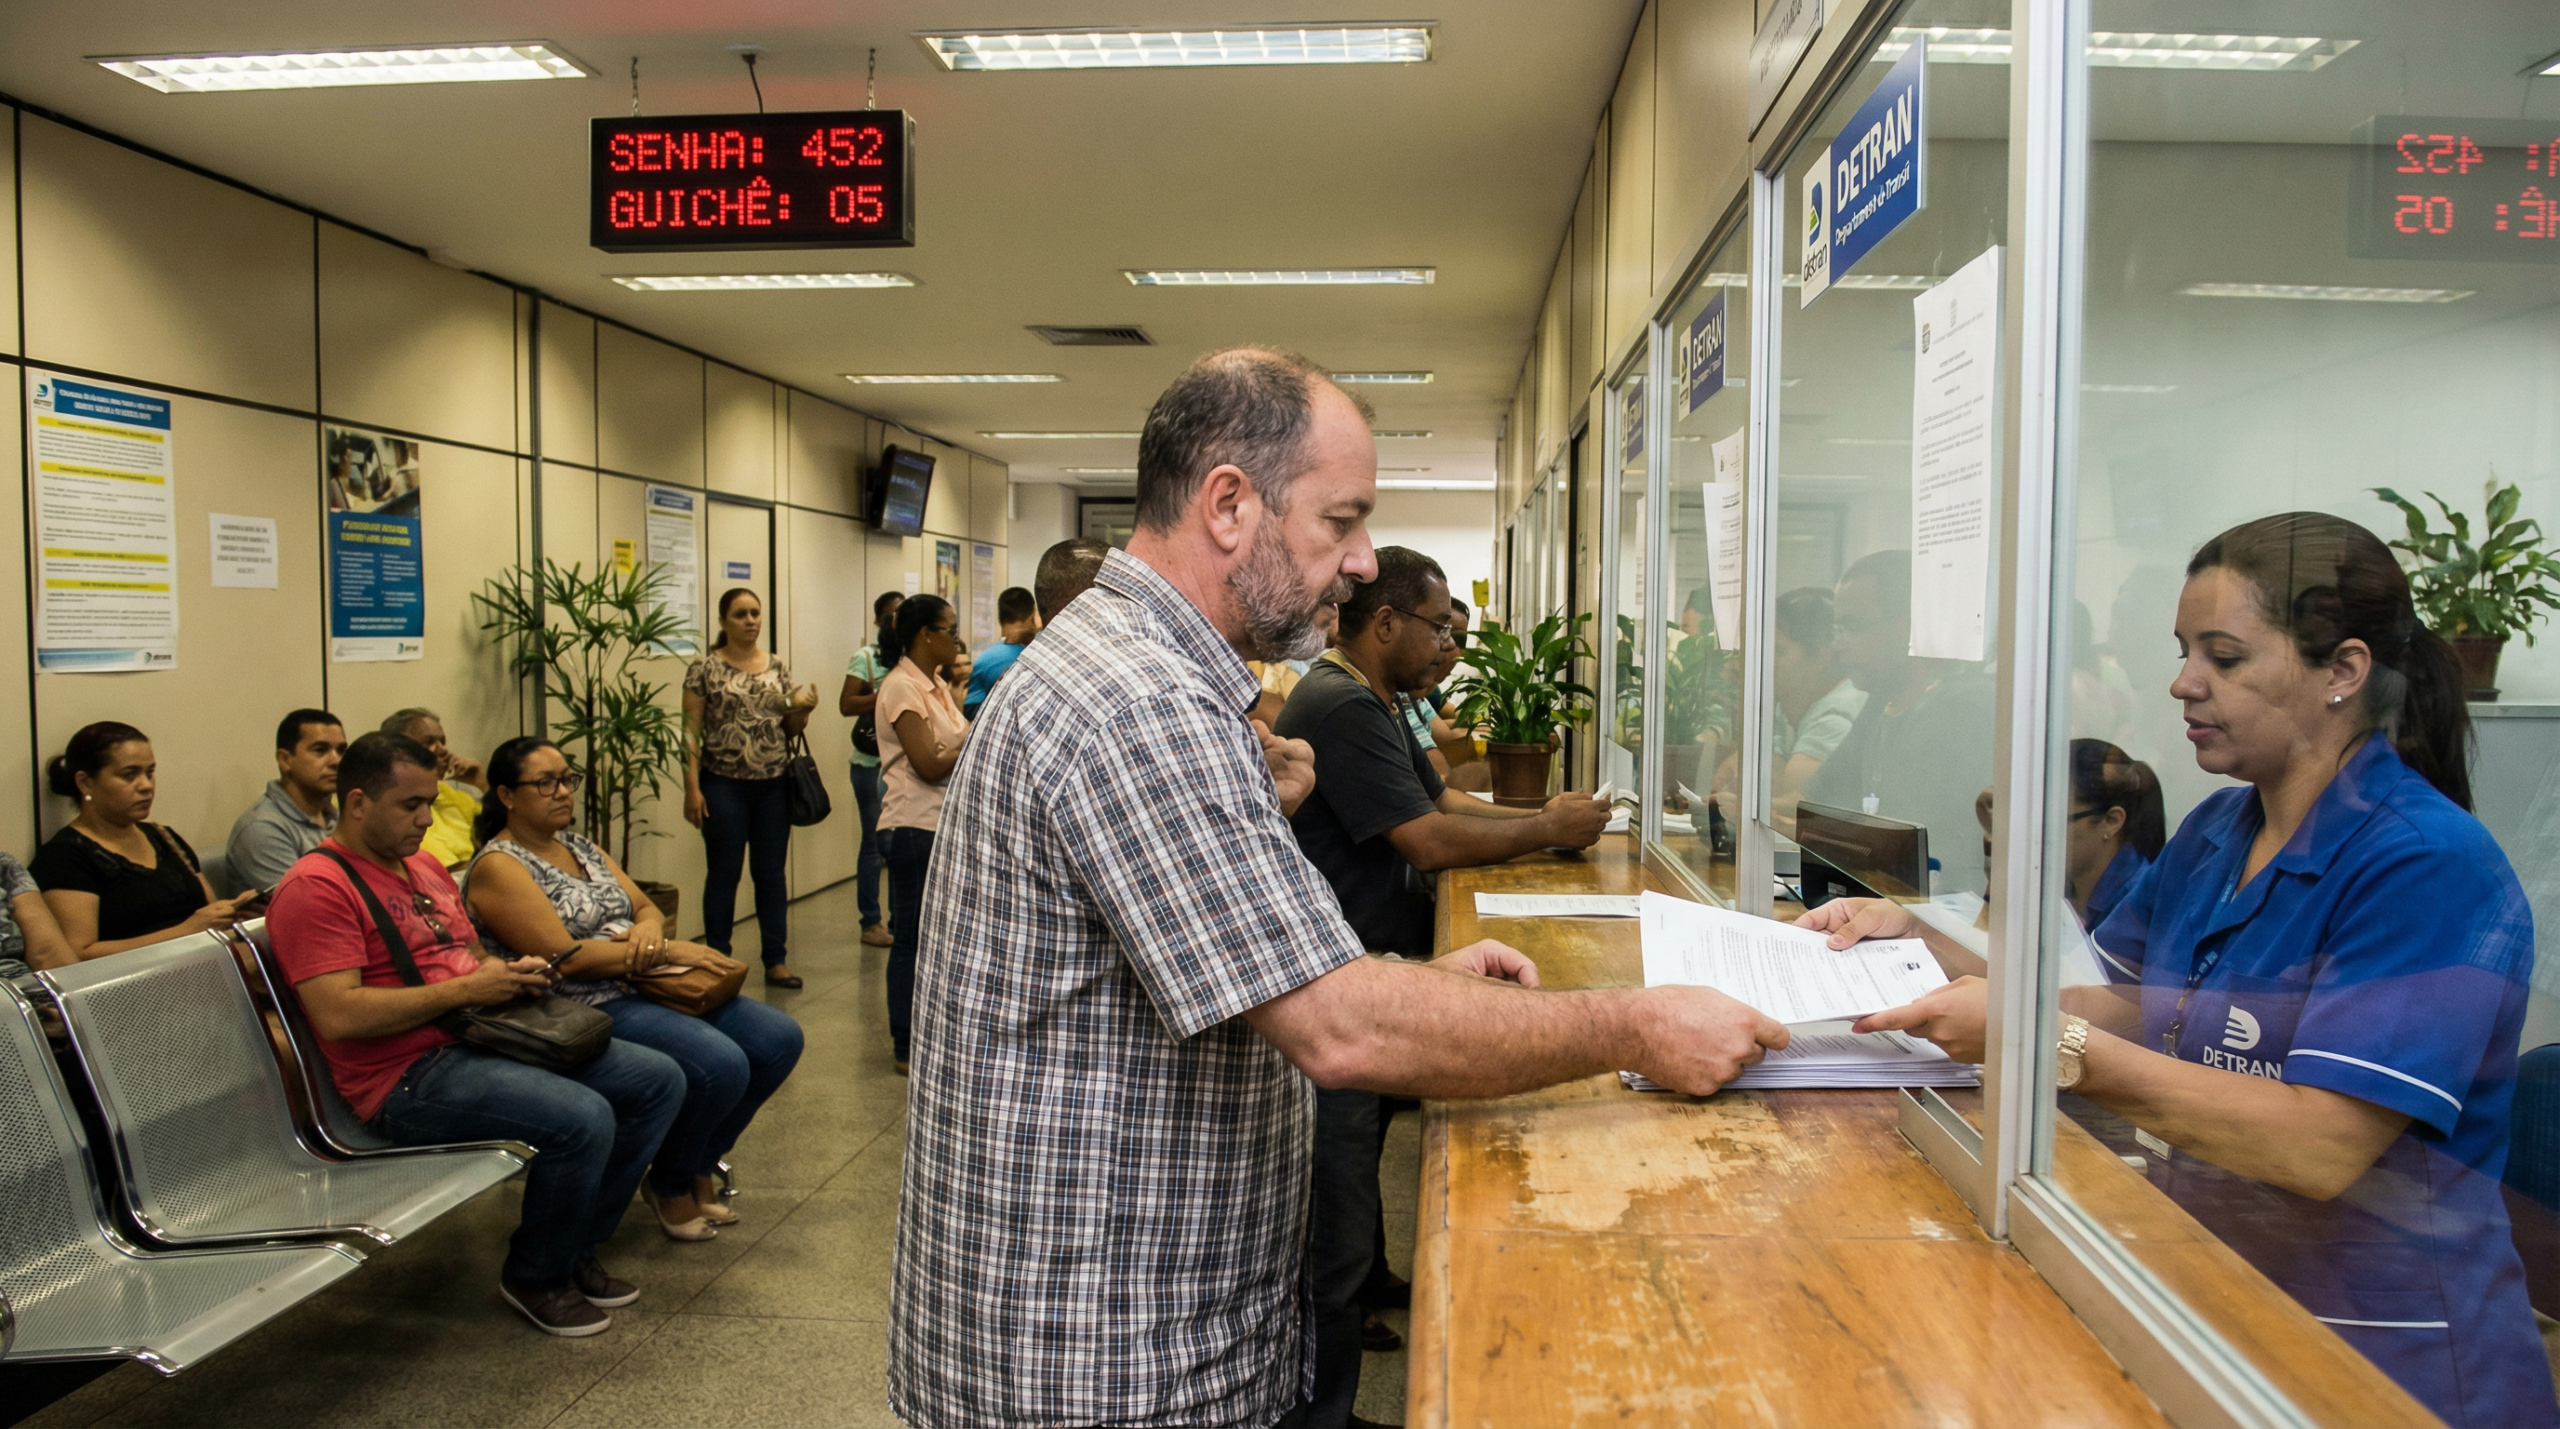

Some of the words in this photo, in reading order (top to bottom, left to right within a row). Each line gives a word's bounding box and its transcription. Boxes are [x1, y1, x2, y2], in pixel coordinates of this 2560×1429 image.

[610, 131, 764, 171] SENHA:
[802, 127, 883, 167] 452
[1837, 83, 1912, 214] DETRAN
[610, 175, 790, 228] GUICHÊ:
[829, 185, 883, 223] 05
[2203, 1045, 2282, 1081] DETRAN
